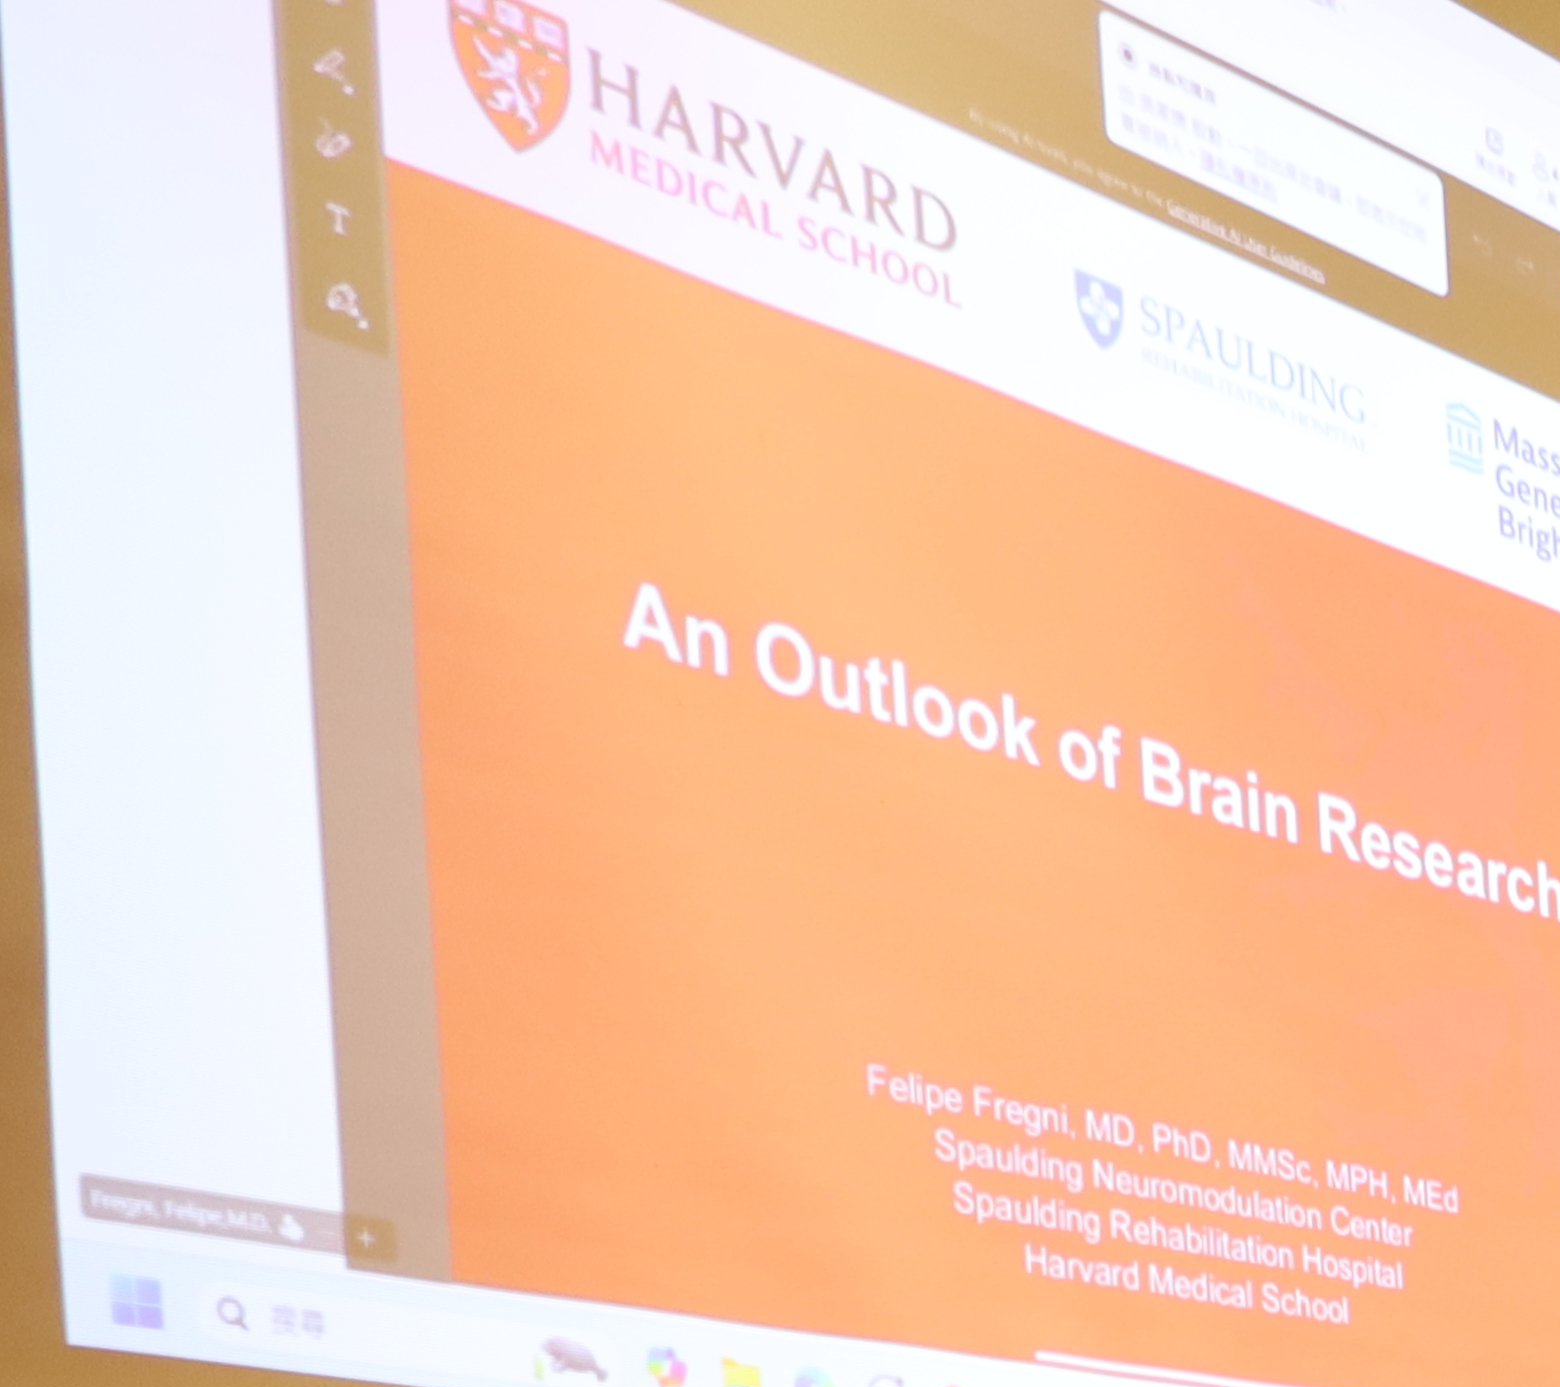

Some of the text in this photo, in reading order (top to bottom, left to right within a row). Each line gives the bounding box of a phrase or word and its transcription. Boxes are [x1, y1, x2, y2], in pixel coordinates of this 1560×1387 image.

[586, 46, 958, 253] HARVARD
[590, 128, 962, 309] MEDICAL SCHOOL
[1139, 295, 1367, 425] SPAULDING
[623, 581, 730, 677] An
[755, 621, 1041, 766] Outlook
[1058, 724, 1122, 789] of
[1140, 736, 1298, 844] Brain
[866, 1062, 1459, 1213] Felipe Fregni, MD, PhD, MMSc, MPH, MEd
[935, 1127, 1414, 1247] Spaulding Neuromodulation Center
[953, 1181, 1404, 1290] Spaulding Rehabilitation Hospital
[1025, 1243, 1350, 1324] Harvard Medical School
